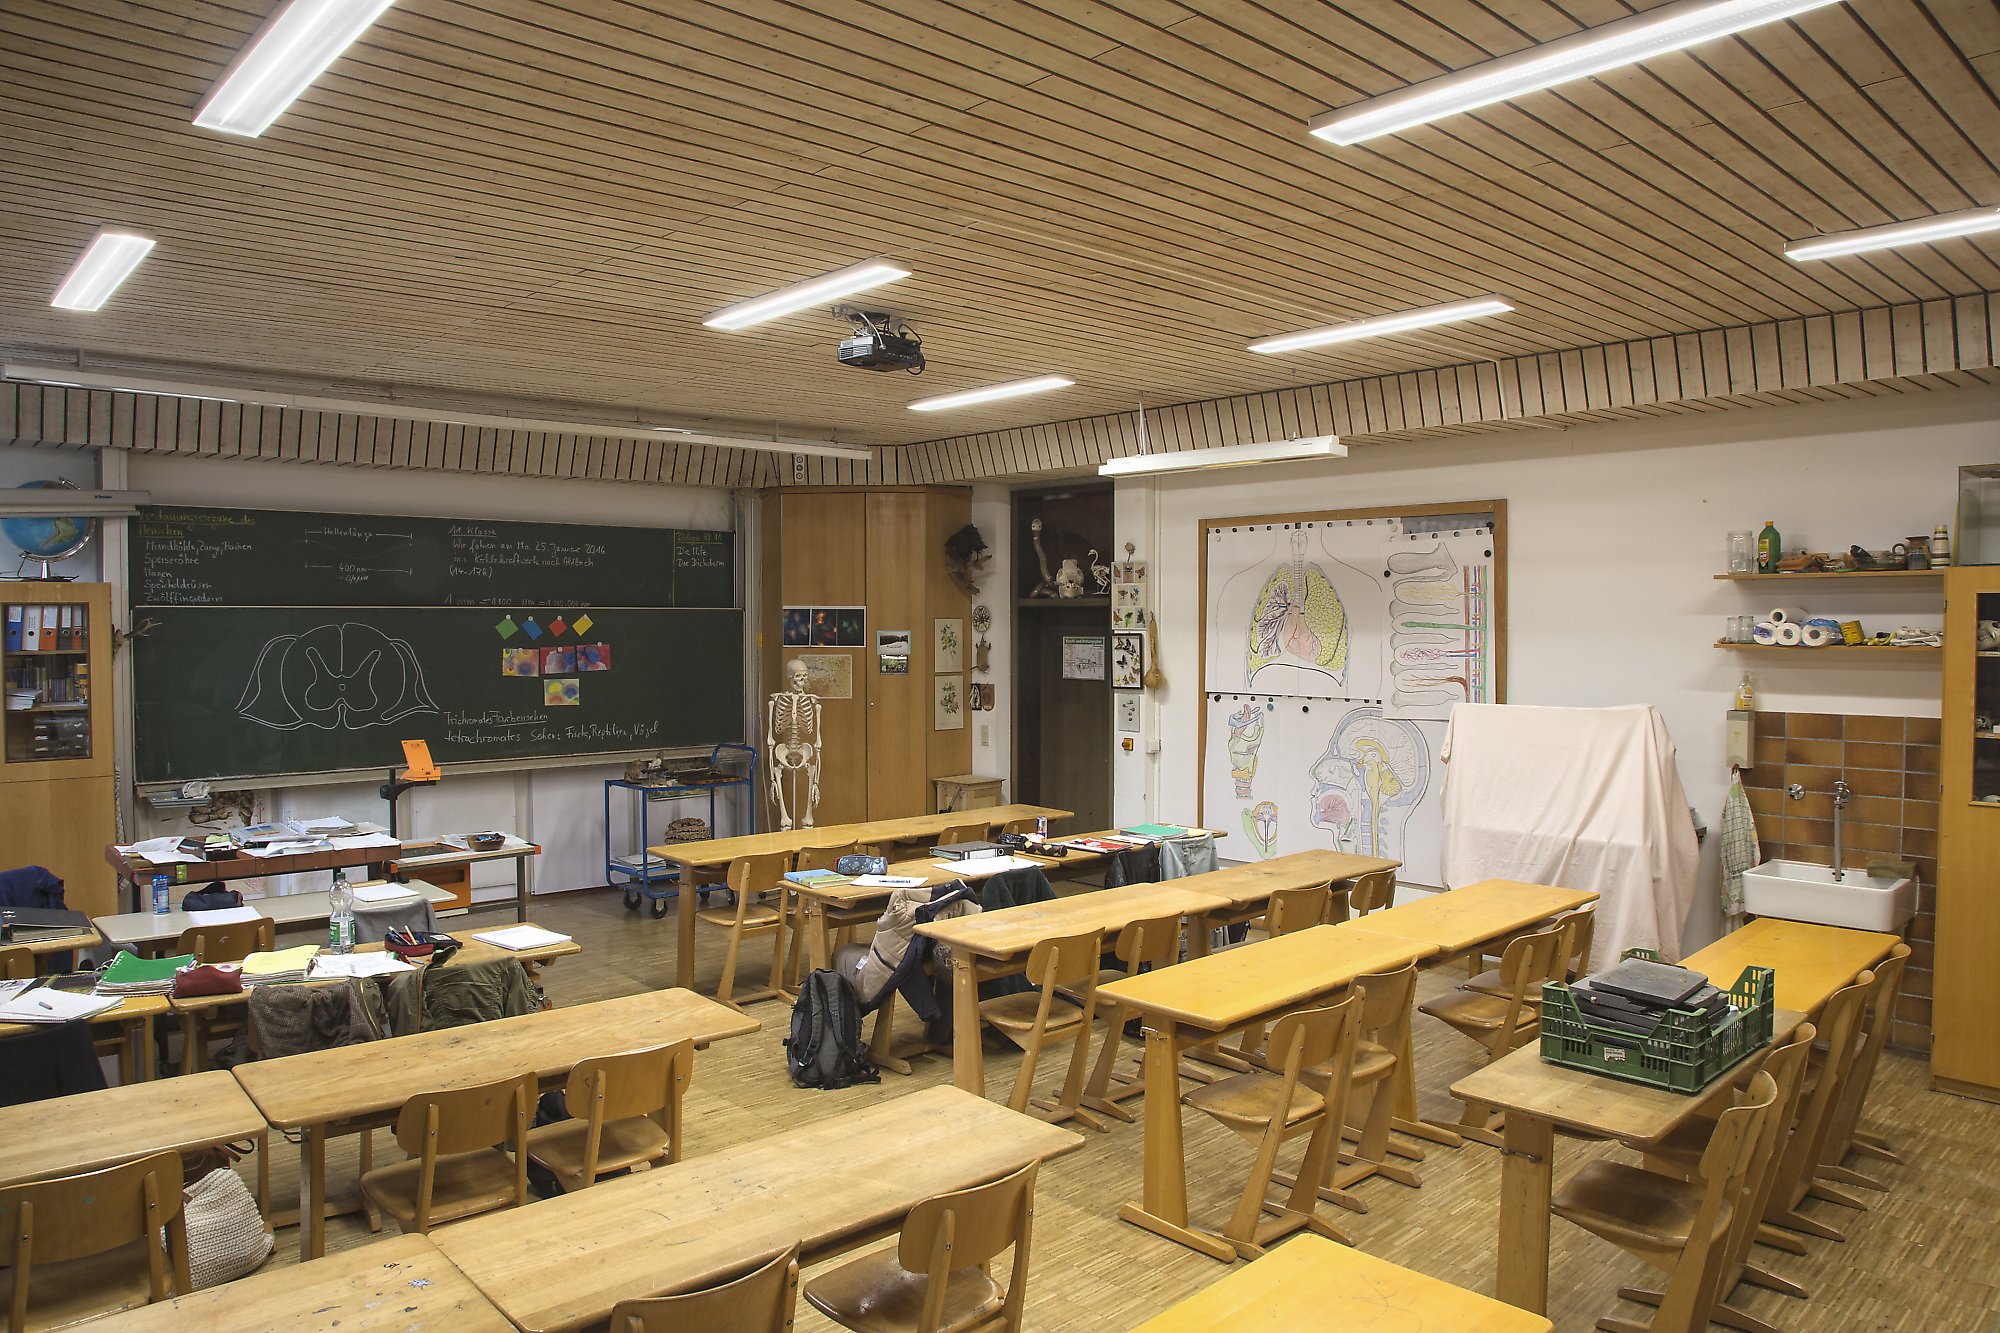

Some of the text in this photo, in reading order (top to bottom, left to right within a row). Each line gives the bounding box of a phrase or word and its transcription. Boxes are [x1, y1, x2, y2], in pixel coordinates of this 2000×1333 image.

[467, 526, 497, 536] Klasse
[453, 539, 467, 549] Wir
[470, 539, 496, 554] fahren
[500, 542, 513, 550] am
[585, 544, 606, 555] 2016
[144, 553, 199, 568] Speiseröhre
[144, 578, 212, 593] Speicheldrüsen
